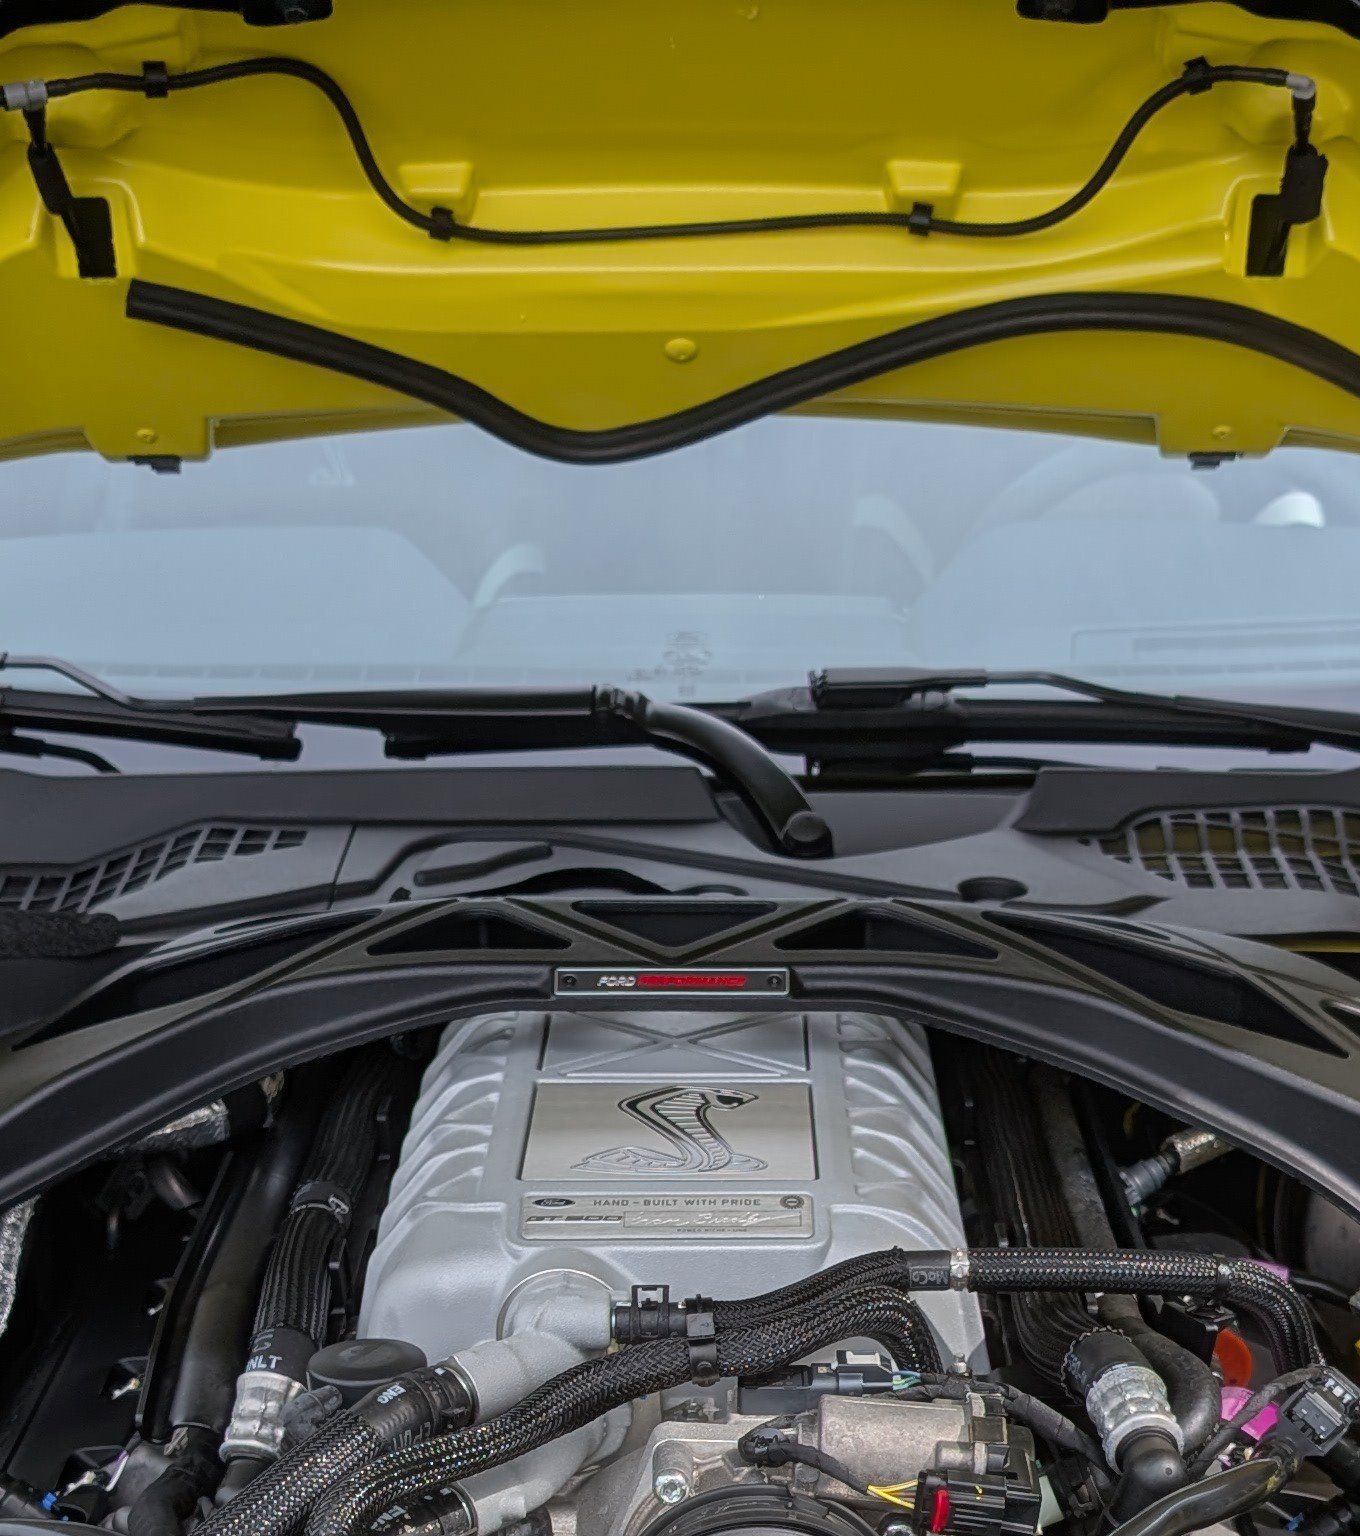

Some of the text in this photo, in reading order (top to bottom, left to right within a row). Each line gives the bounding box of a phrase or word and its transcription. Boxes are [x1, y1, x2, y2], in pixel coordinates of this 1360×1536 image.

[596, 975, 636, 987] FORD
[593, 1199, 629, 1207] HAND
[643, 1198, 678, 1207] BUILT
[683, 1198, 718, 1207] WITH
[721, 1198, 761, 1207] PRIDE
